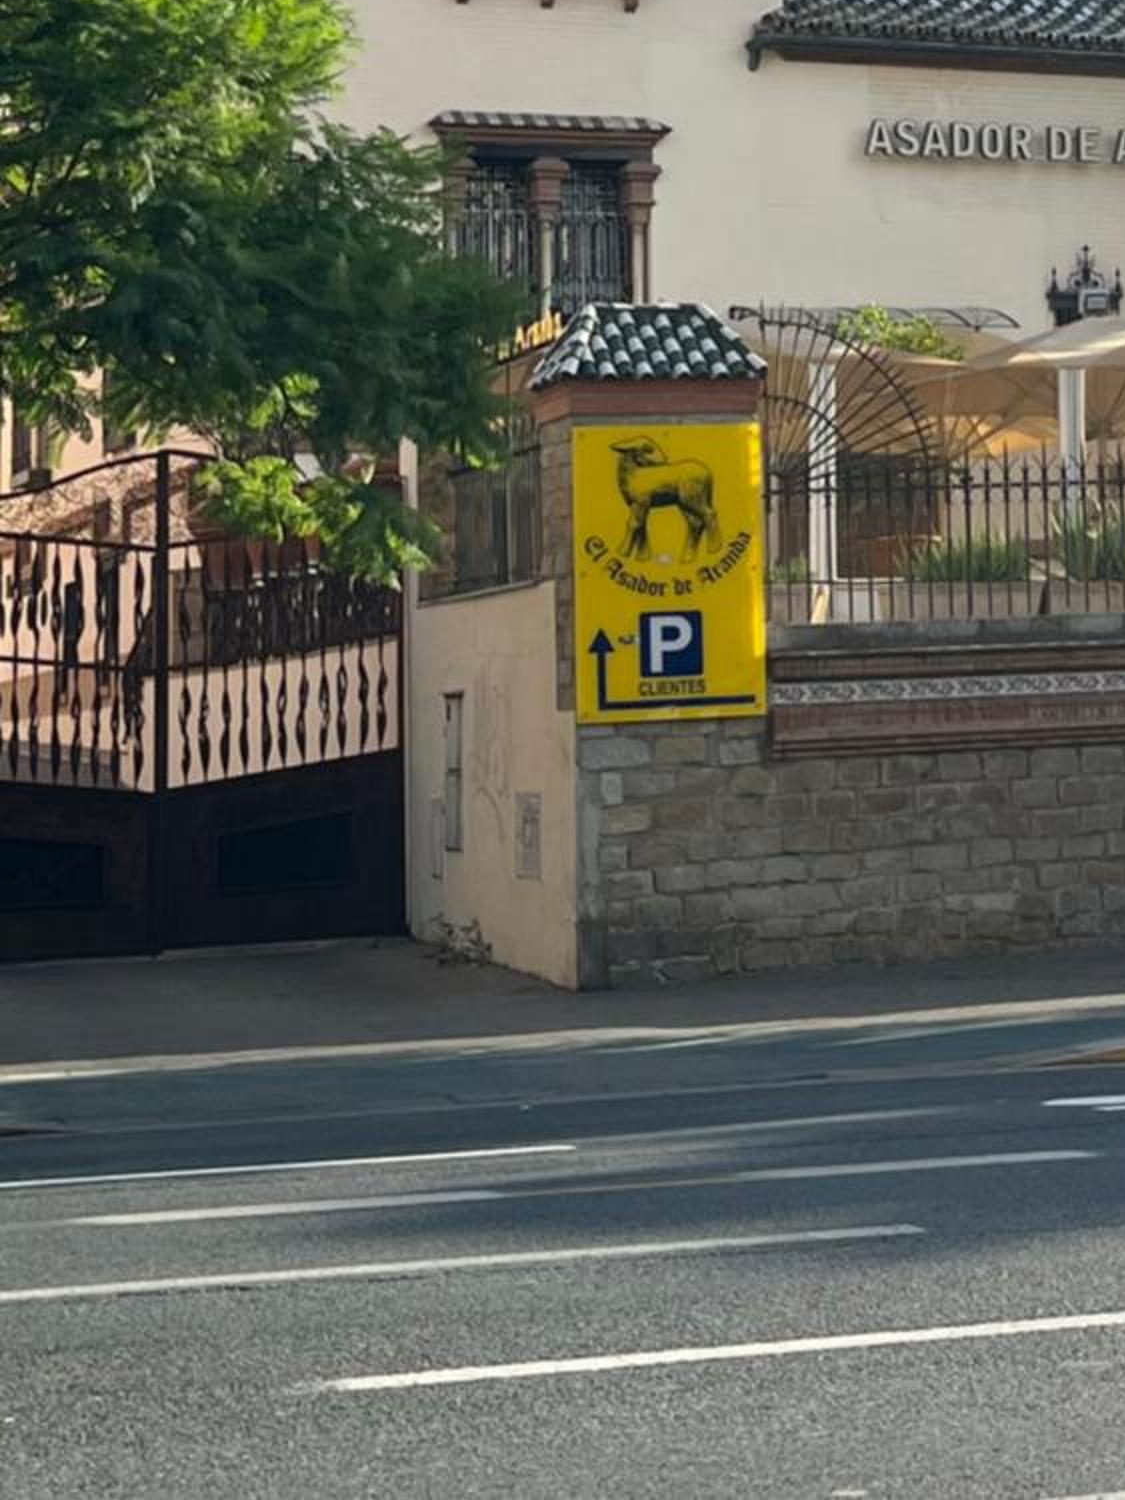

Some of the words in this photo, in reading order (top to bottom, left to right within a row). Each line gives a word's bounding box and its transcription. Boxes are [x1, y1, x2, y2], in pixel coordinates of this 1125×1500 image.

[865, 118, 1032, 160] ASADOR
[1045, 125, 1100, 163] DE
[607, 558, 668, 597] Asador
[672, 577, 692, 596] de
[696, 531, 752, 585] Aranda
[649, 614, 693, 674] P
[639, 679, 706, 696] CLIENTES
